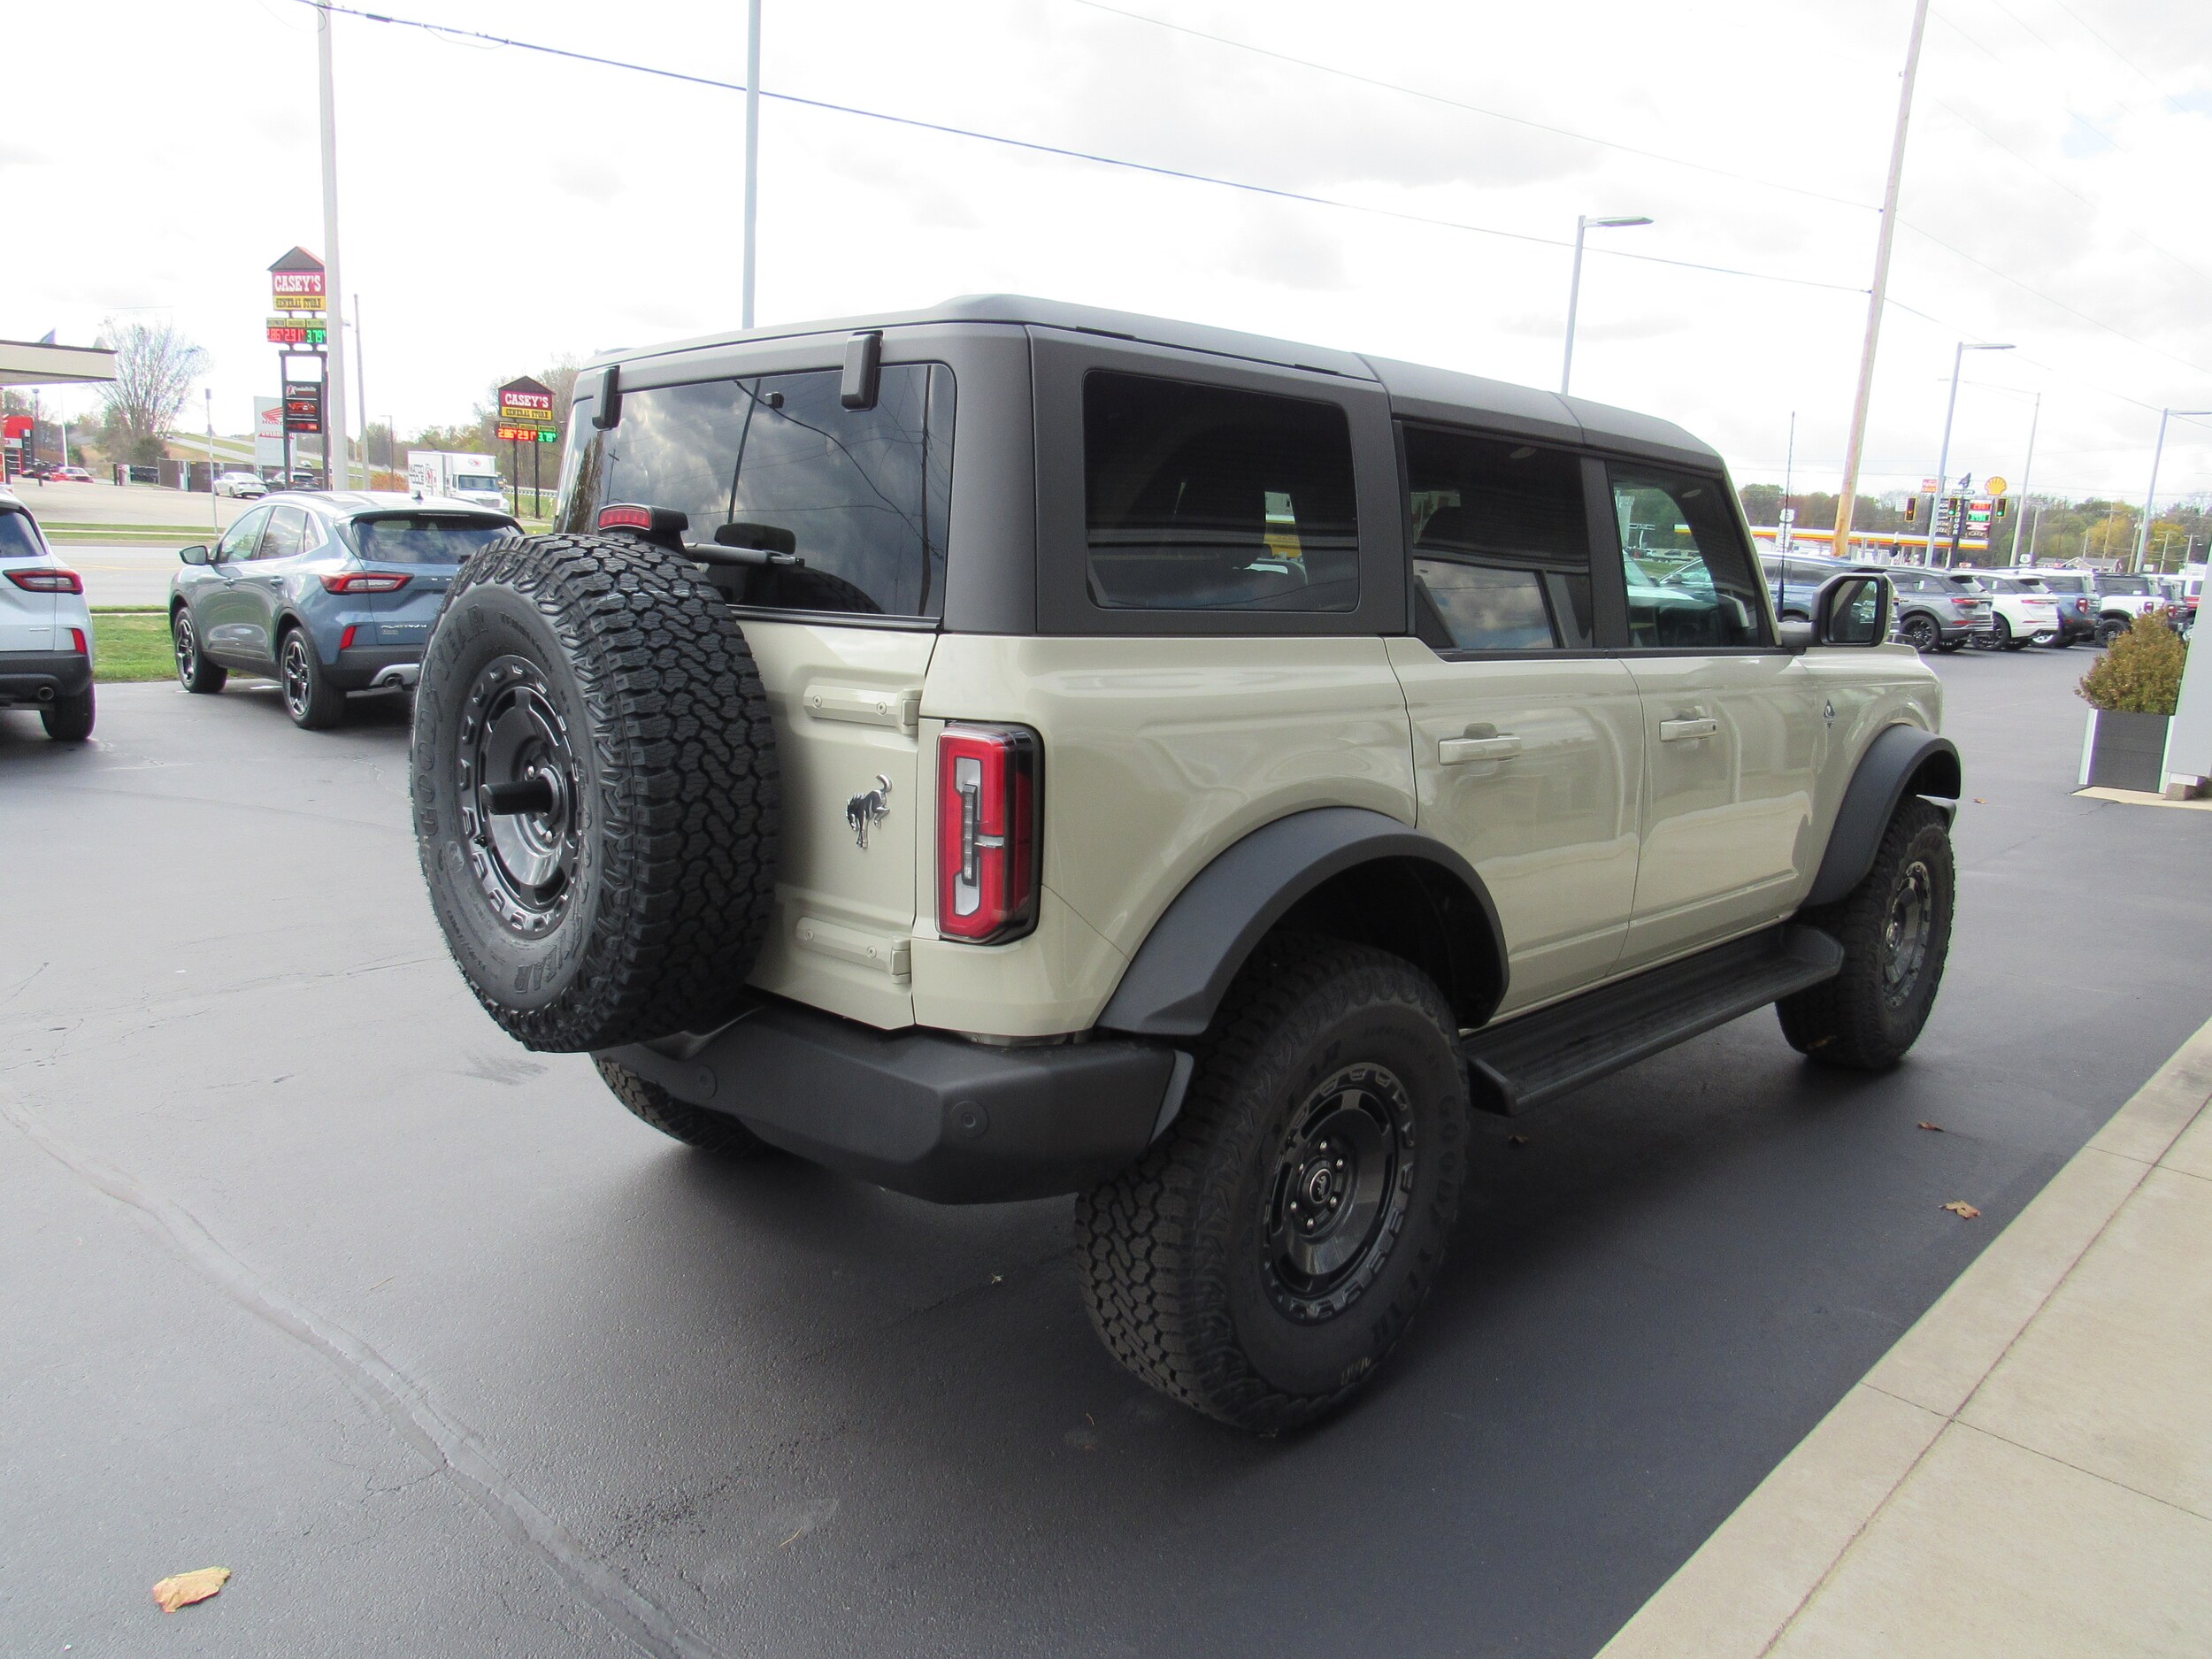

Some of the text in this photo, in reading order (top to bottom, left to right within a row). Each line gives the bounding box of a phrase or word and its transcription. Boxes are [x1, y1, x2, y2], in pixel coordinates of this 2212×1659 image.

[274, 274, 321, 292] CASEY'S
[505, 393, 549, 408] CASEY'S
[1952, 498, 1962, 535] LIQUOR
